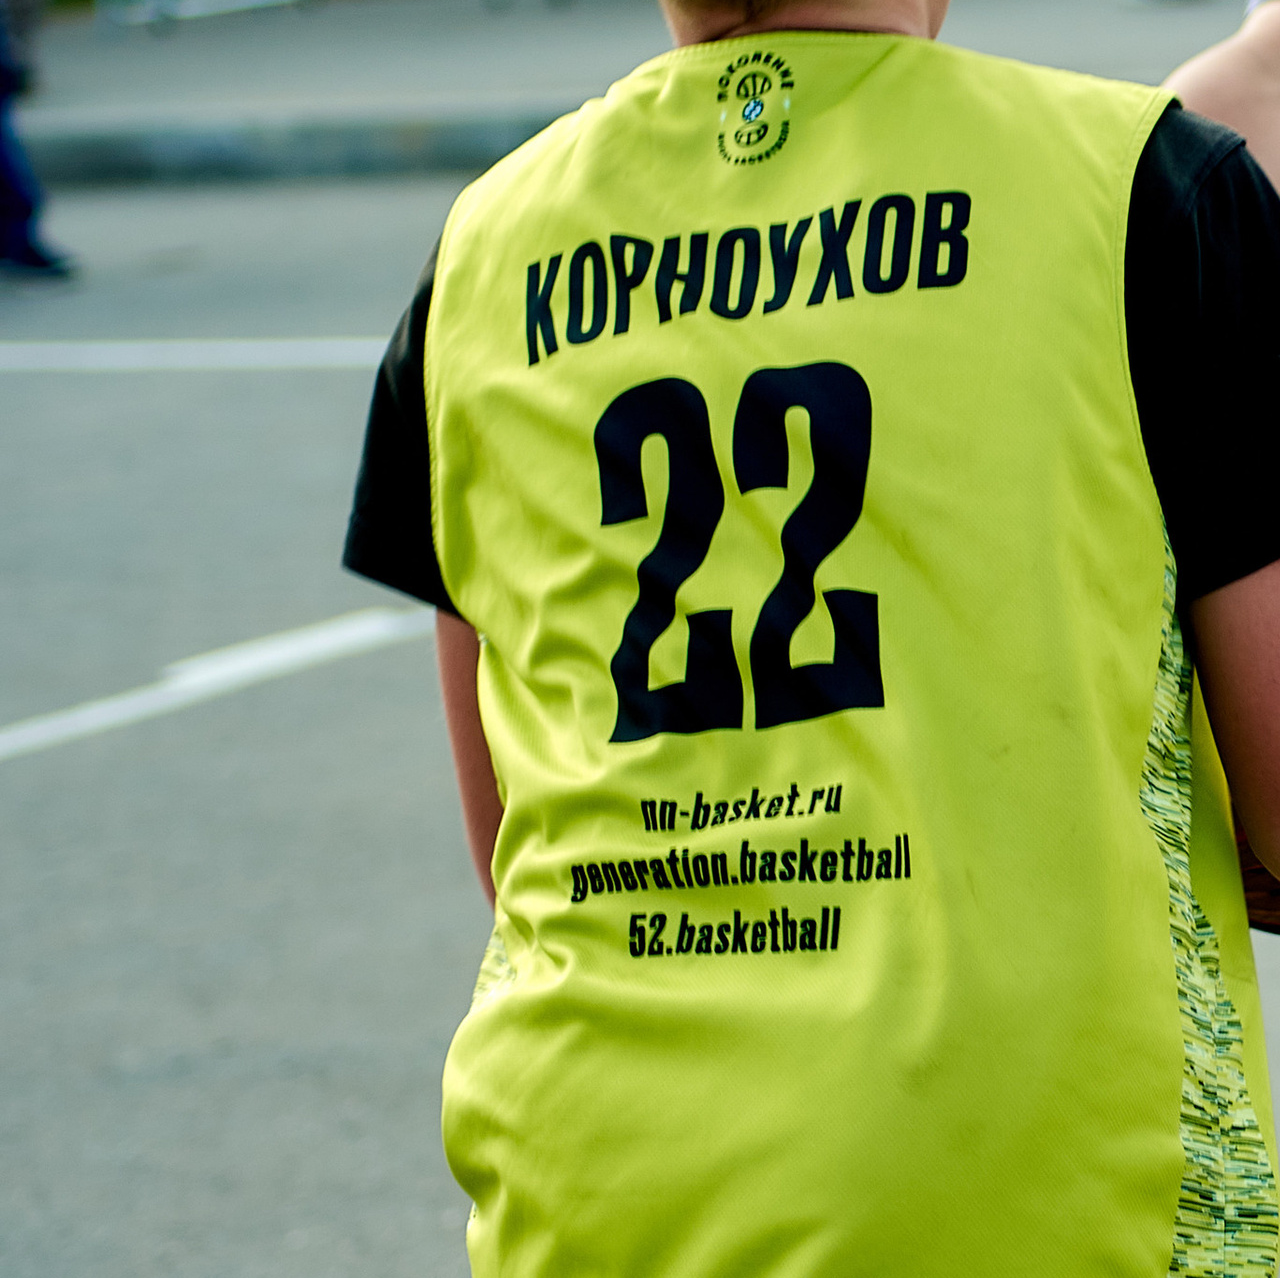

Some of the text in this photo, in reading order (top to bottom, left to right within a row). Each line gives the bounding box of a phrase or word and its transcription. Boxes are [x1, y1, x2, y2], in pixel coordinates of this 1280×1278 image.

[526, 190, 972, 366] КОРНОУХОВ
[594, 361, 885, 743] 22
[641, 782, 843, 832] nn-basket.ru
[571, 833, 912, 903] generation.basketball
[629, 906, 842, 958] 52.basketball
